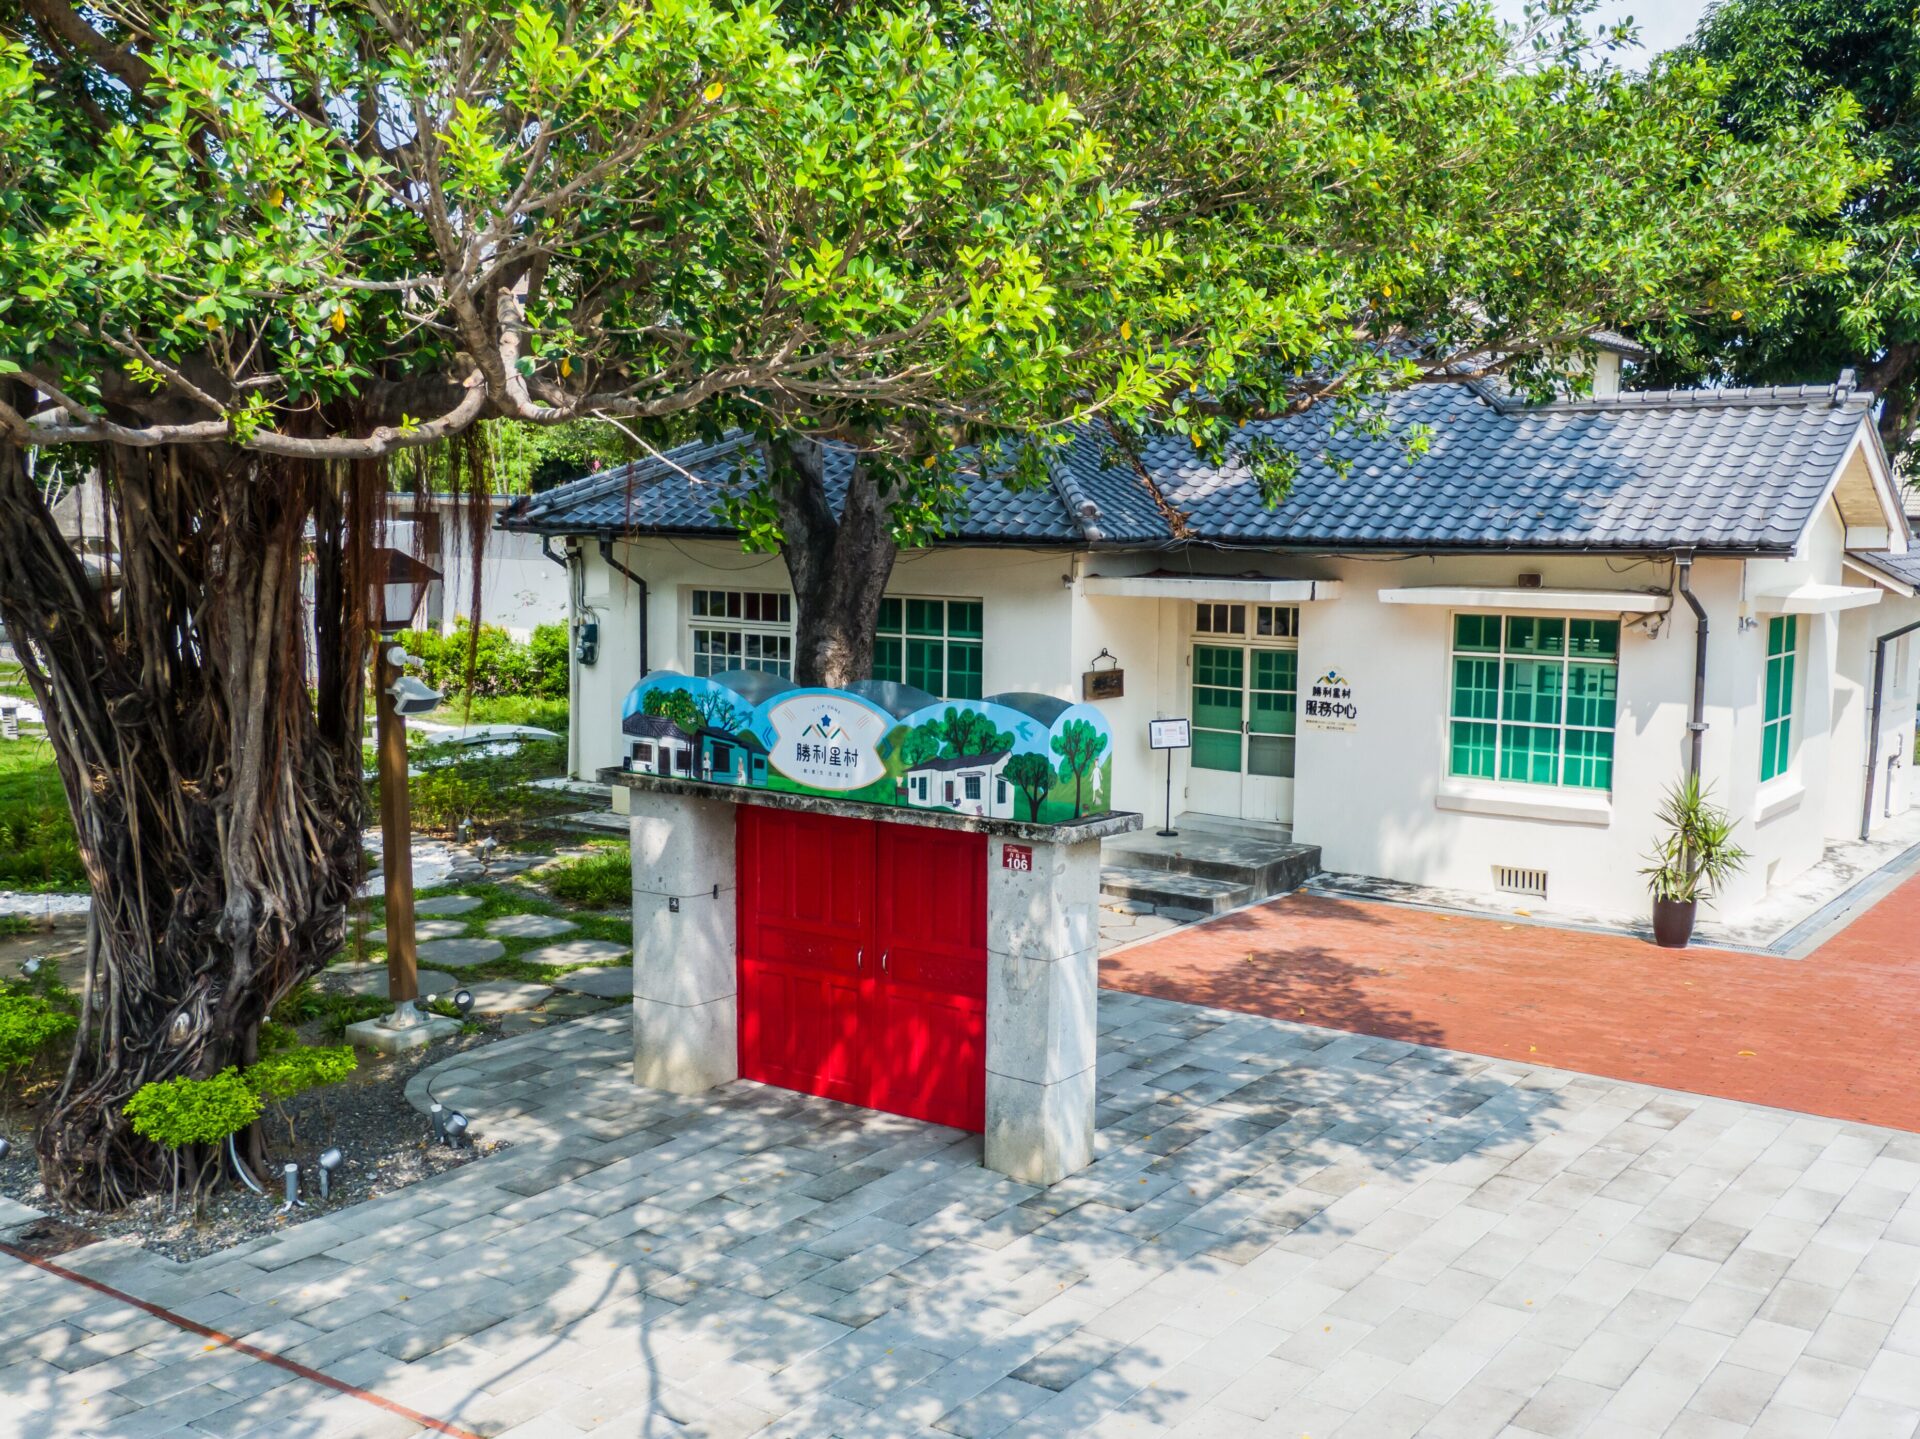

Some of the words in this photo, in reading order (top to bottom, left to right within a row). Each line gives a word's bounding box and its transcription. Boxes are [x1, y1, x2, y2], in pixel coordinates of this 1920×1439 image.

[1305, 700, 1357, 719] 服務中心
[796, 743, 859, 767] 勝利星村
[1006, 858, 1028, 870] 106
